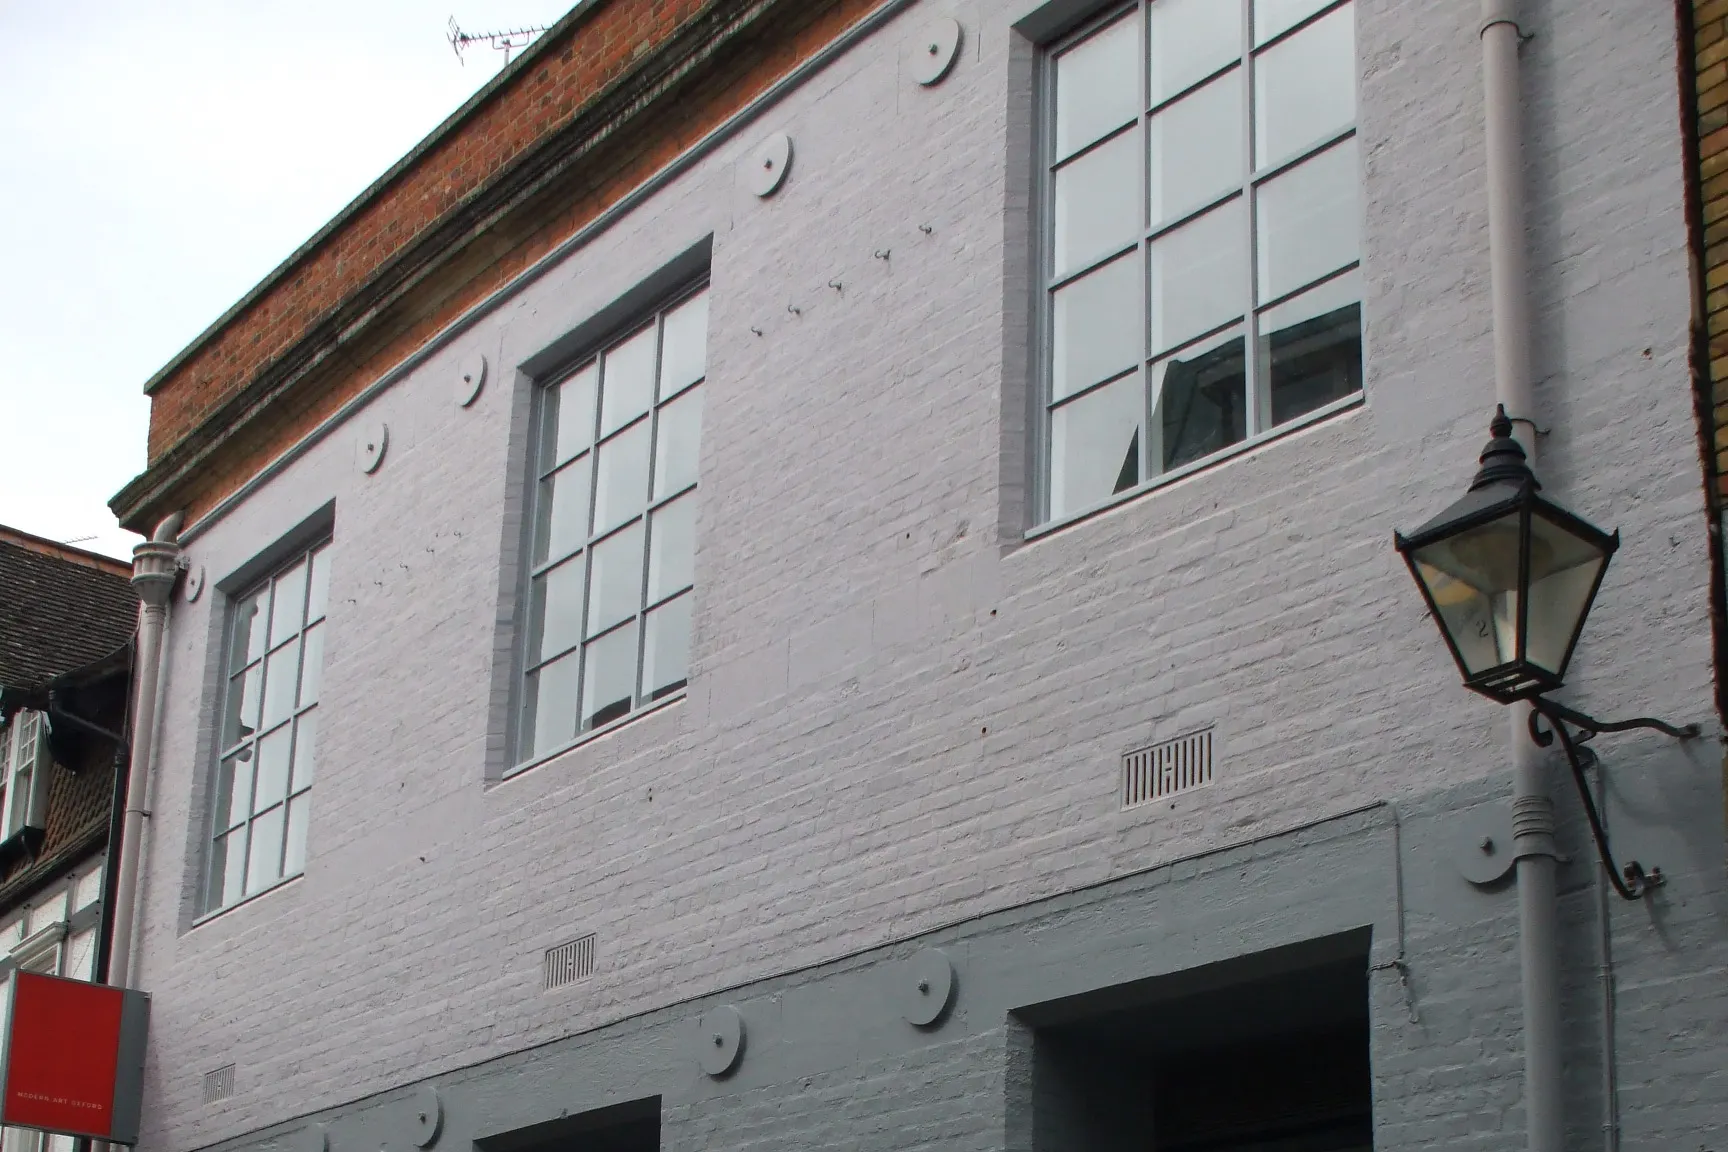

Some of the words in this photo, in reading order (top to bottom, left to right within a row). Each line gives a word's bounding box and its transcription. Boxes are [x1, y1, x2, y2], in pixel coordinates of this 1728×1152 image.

[17, 1091, 50, 1103] MODERN
[53, 1096, 68, 1105] ART
[71, 1099, 103, 1110] OXFORD
